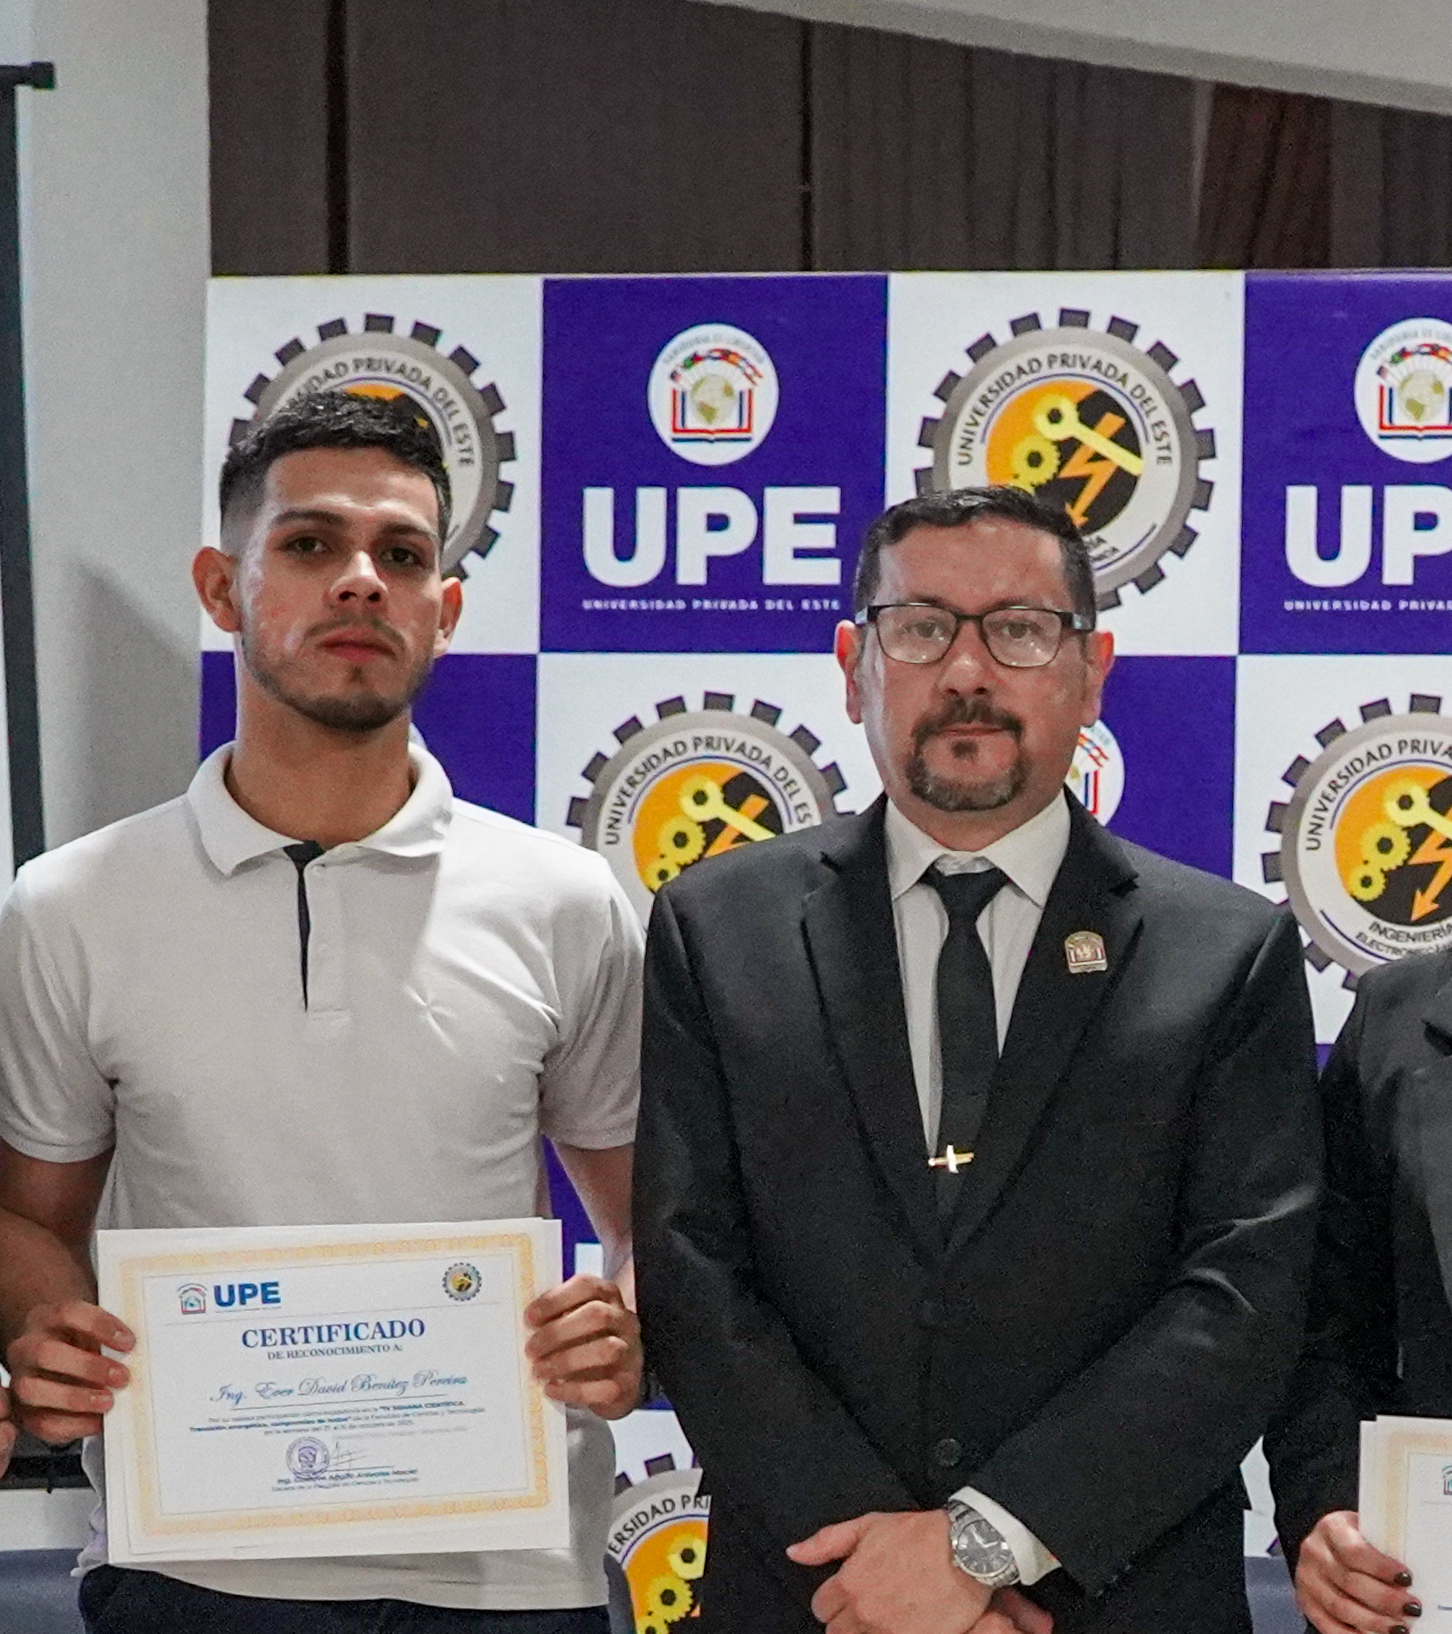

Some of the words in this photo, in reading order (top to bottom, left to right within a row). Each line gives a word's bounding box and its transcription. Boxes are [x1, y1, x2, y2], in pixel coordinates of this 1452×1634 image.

[352, 357, 431, 390] PRIVADA
[959, 357, 1043, 466] UNIVERSIDAD
[1048, 353, 1130, 386] PRIVADA
[1130, 384, 1158, 418] DEL
[1151, 420, 1173, 465] ESTE
[583, 486, 841, 587] UPE
[582, 599, 686, 610] UNIVERSIDAD
[692, 599, 759, 610] PRIVADA
[765, 599, 793, 610] DEL
[1284, 600, 1391, 611] UNIVERSIDAD
[605, 740, 688, 845] UNIVERSIDAD
[693, 736, 772, 770] PRIVADA
[773, 766, 801, 800] DEL
[794, 801, 813, 824] ES
[1306, 742, 1393, 852] UNIVERSIDAD
[213, 1281, 281, 1307] UPE
[242, 1318, 426, 1349] CERTIFICADO
[267, 1352, 284, 1360] DE
[608, 1499, 675, 1555] ERSIDAD
